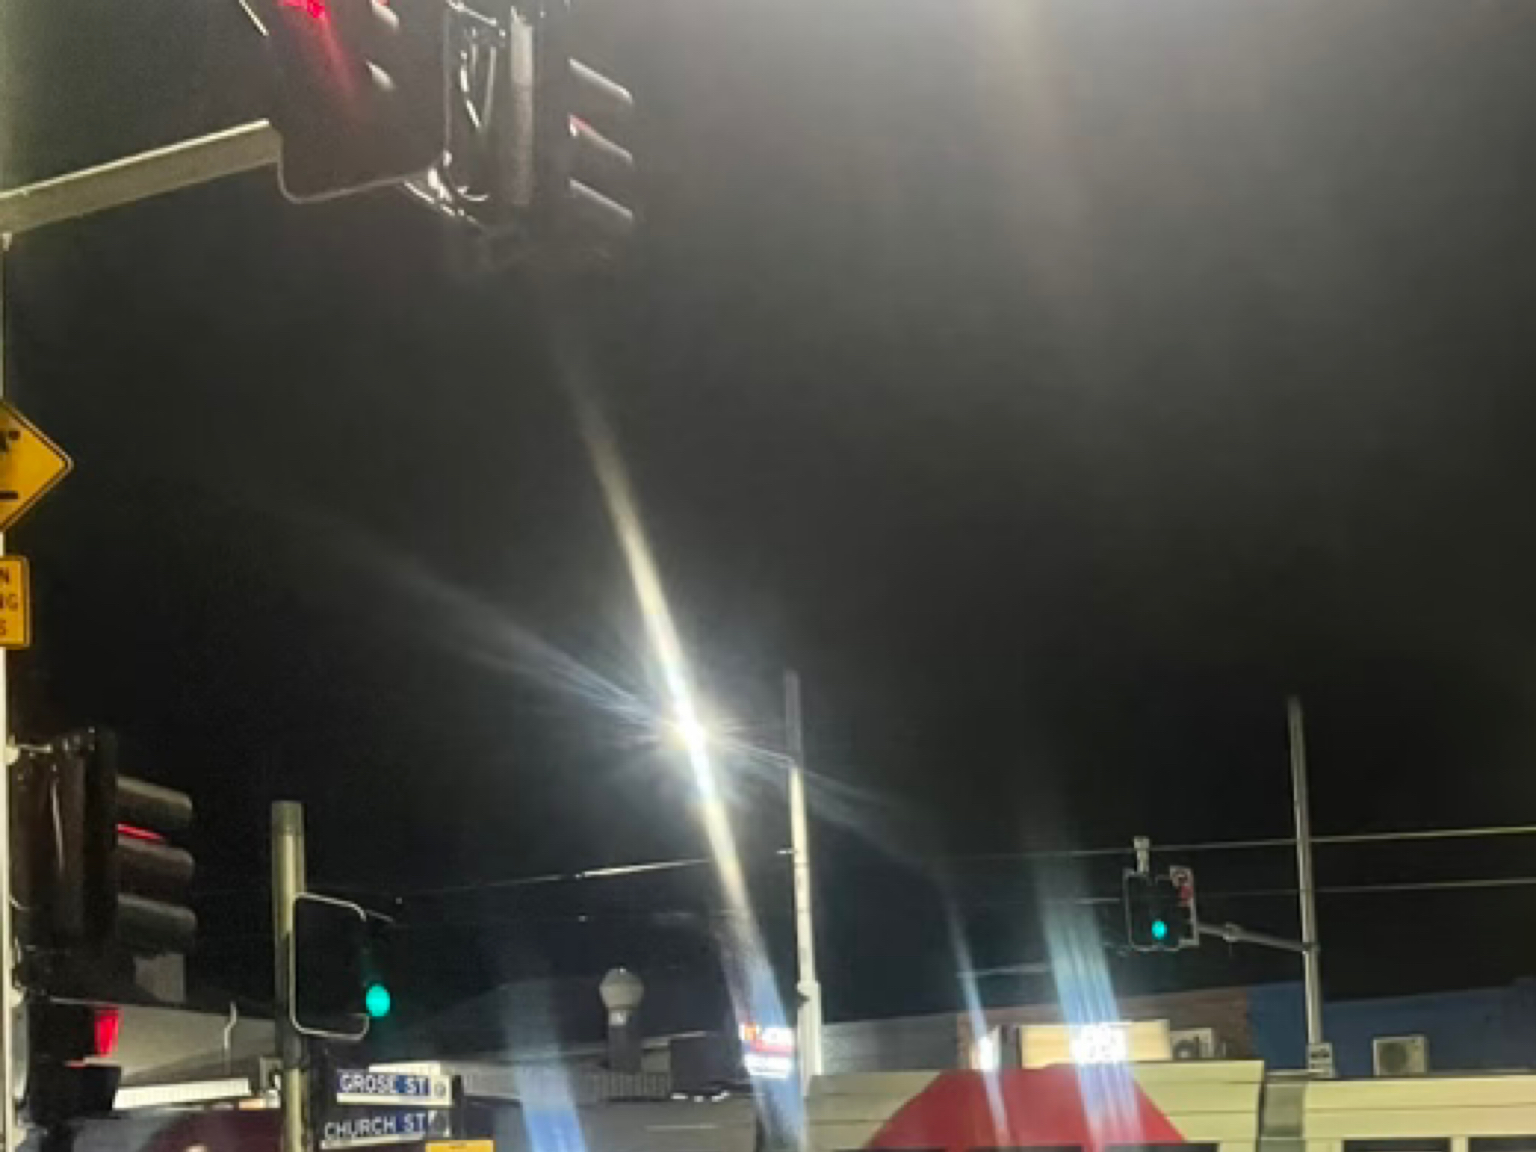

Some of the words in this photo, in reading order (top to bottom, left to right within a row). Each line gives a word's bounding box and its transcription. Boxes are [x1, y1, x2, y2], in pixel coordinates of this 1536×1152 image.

[340, 1074, 397, 1094] GROSE
[406, 1076, 426, 1094] ST
[324, 1116, 396, 1141] CHURCH
[403, 1113, 426, 1133] ST
